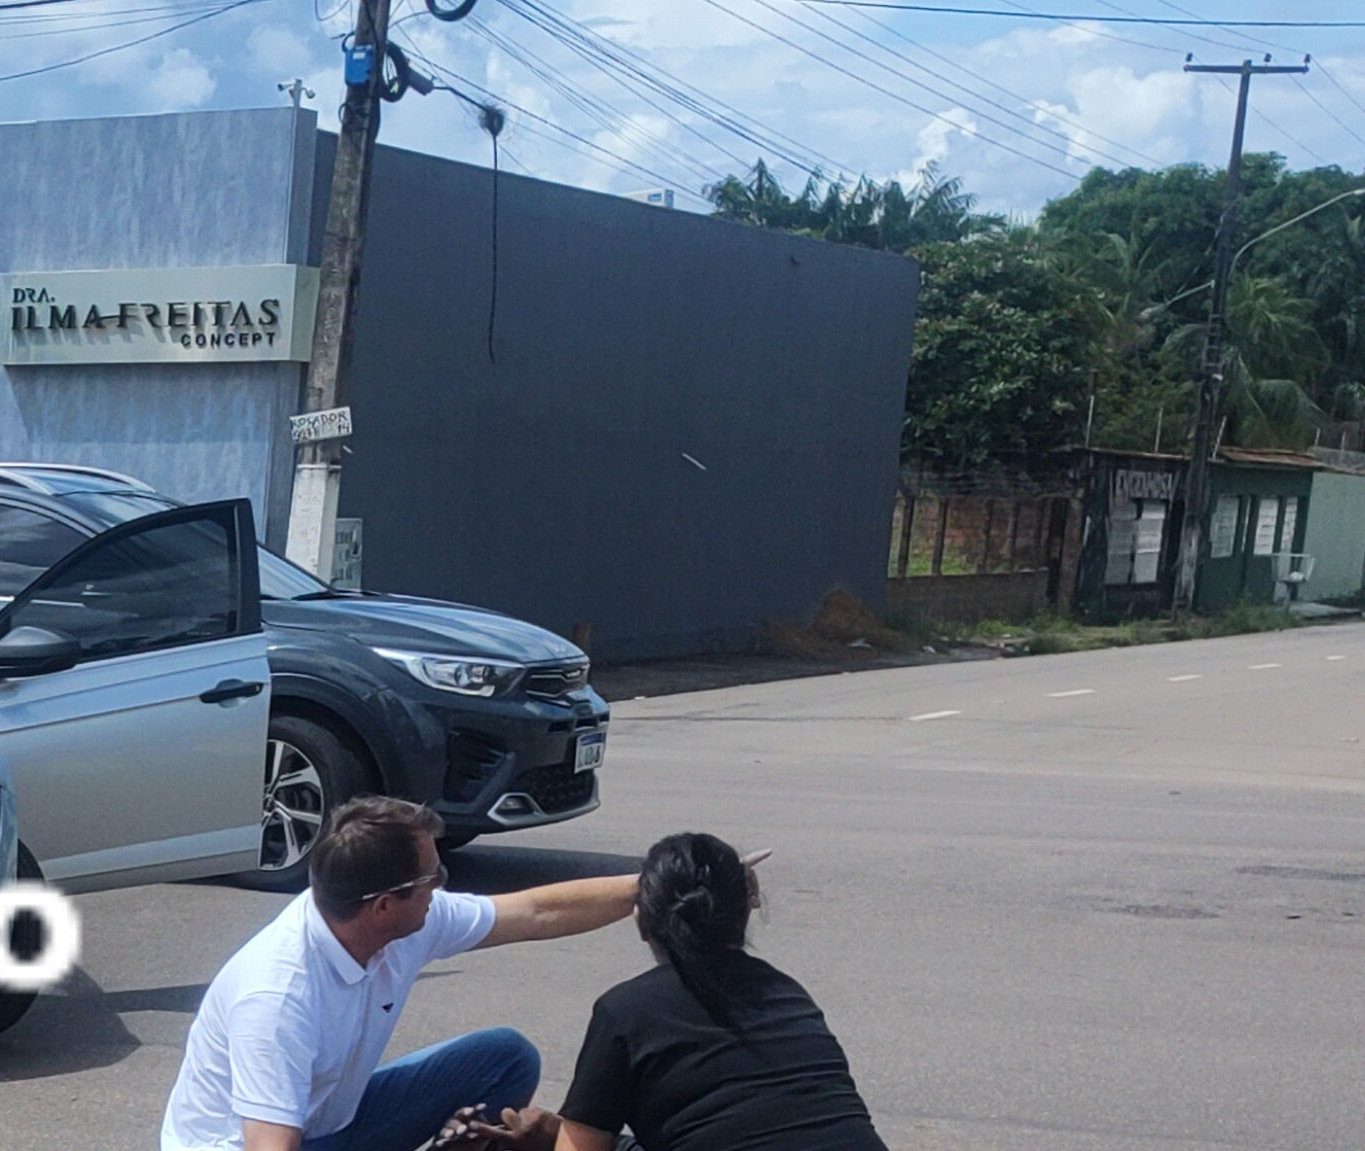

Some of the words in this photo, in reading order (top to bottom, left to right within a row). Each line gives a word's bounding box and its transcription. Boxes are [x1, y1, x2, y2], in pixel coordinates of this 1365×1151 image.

[11, 304, 107, 331] ILMA
[116, 298, 280, 329] FREITAS
[180, 331, 277, 349] CONCEPT
